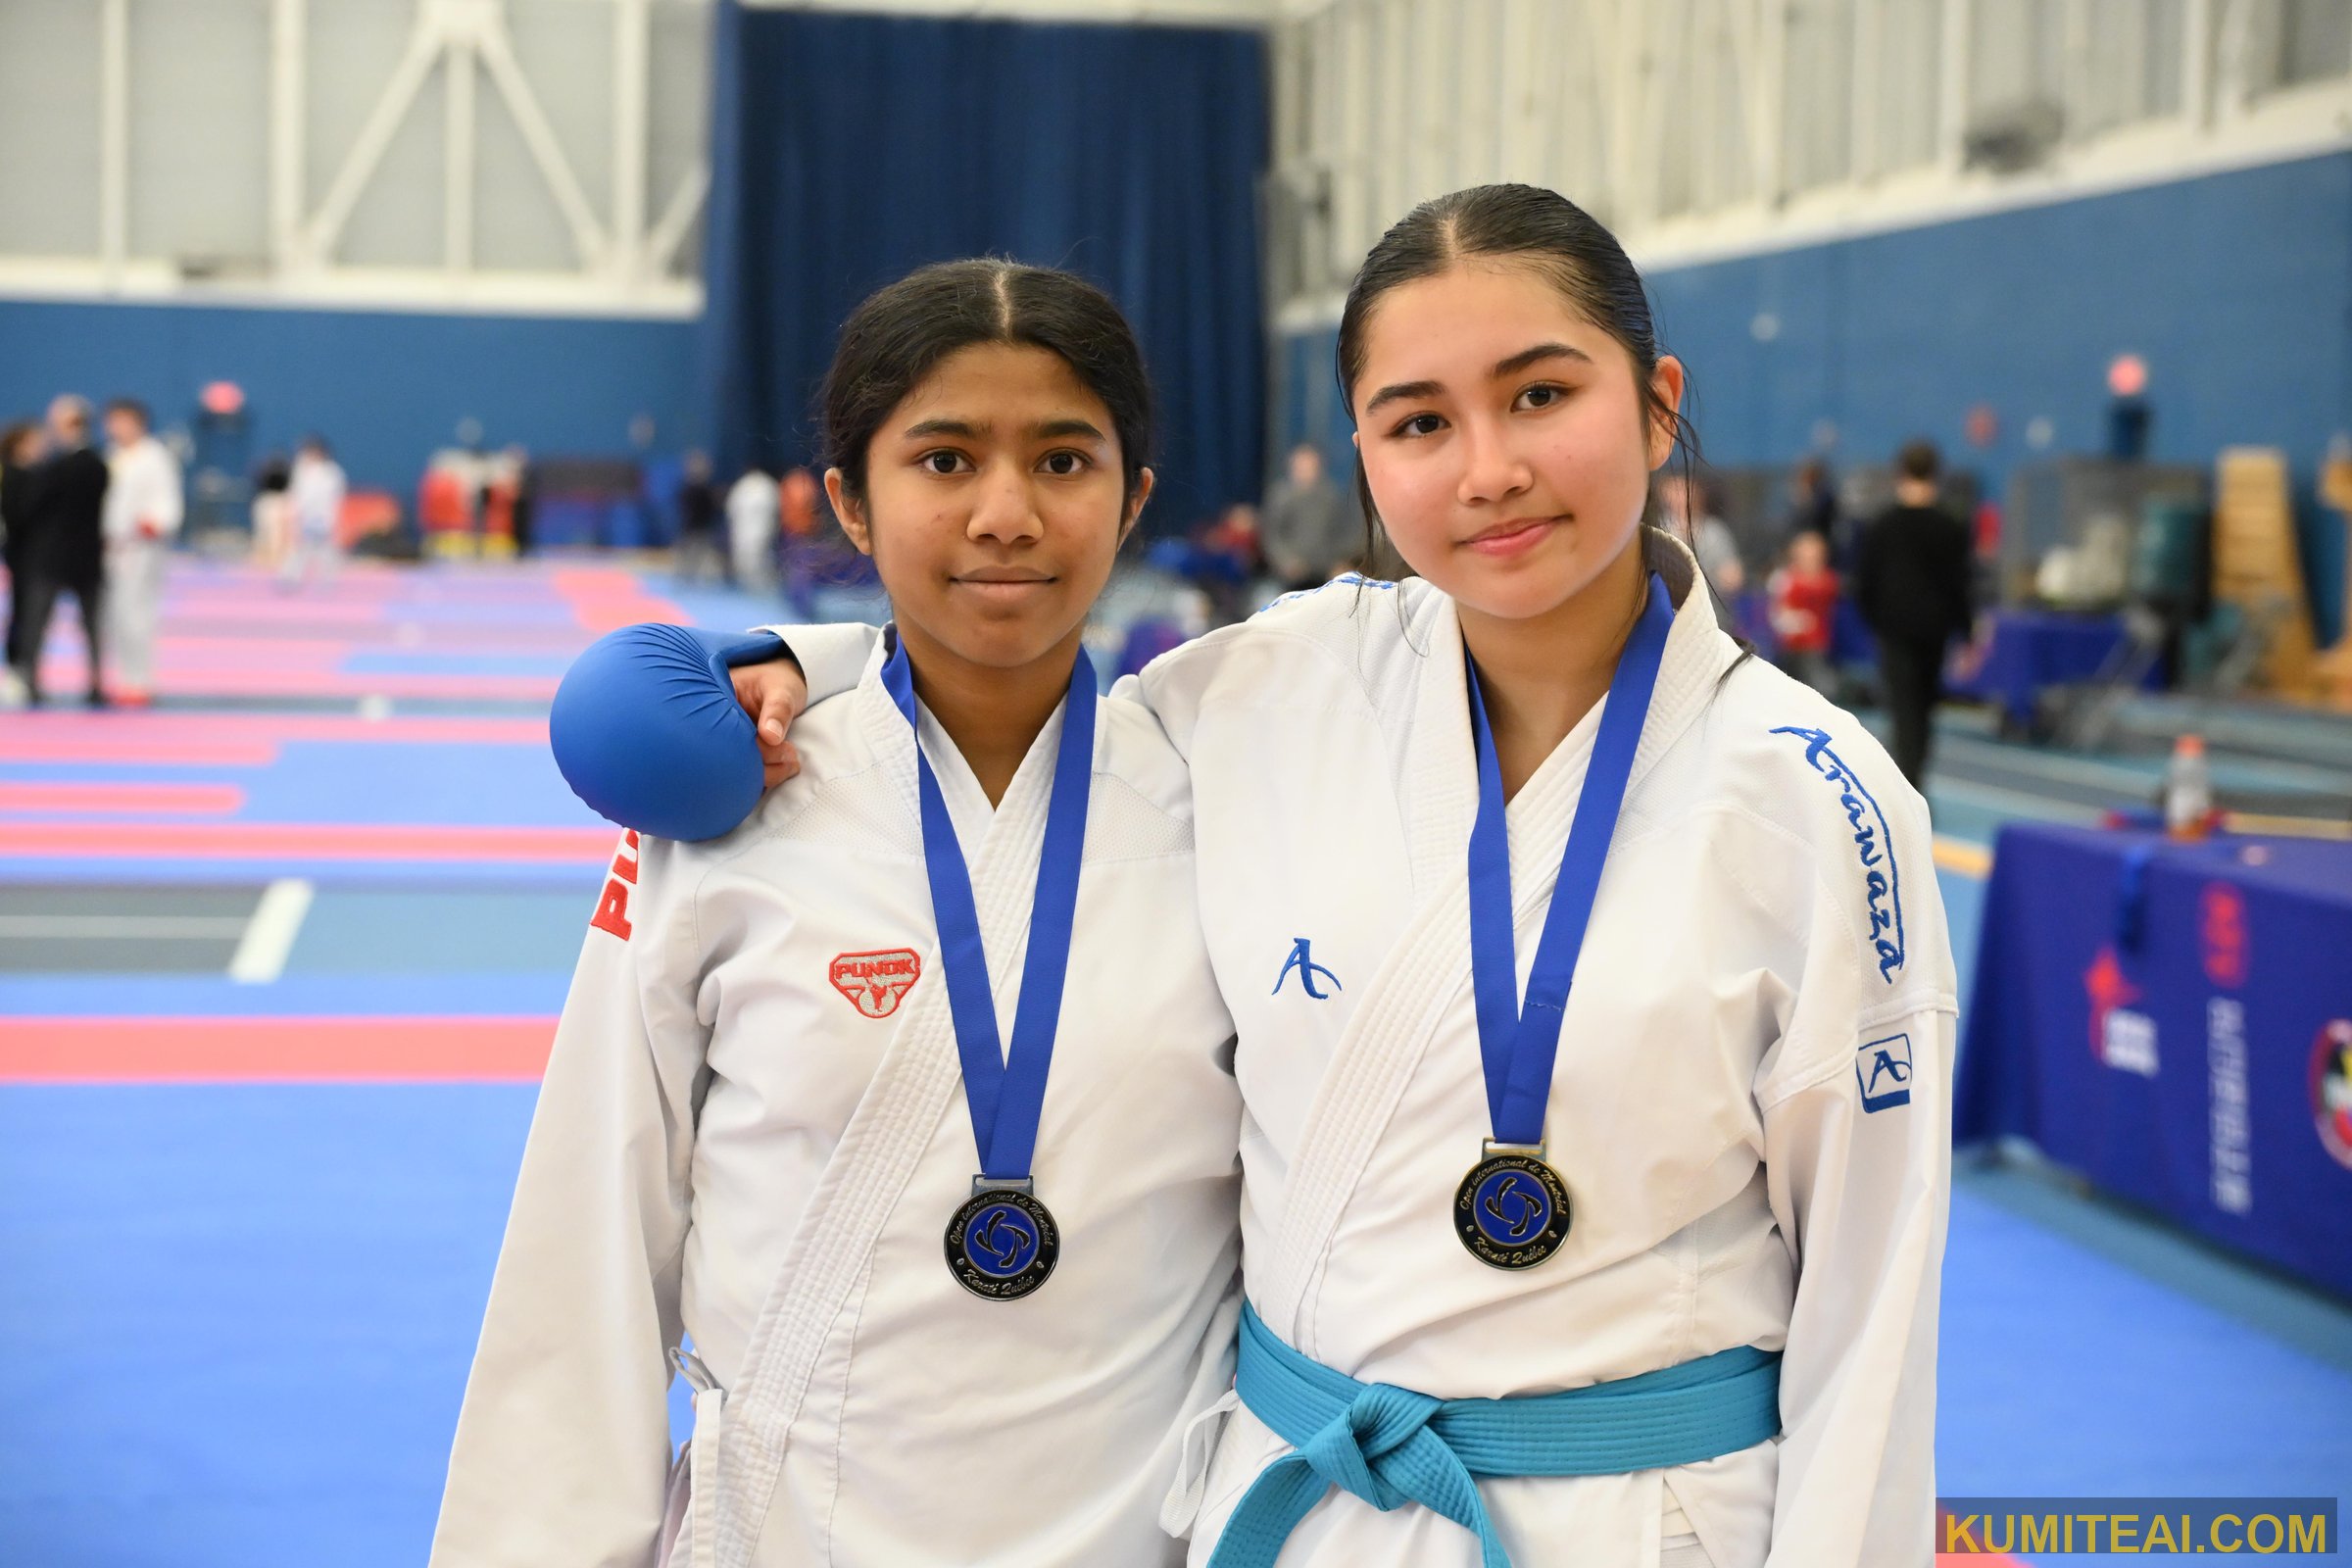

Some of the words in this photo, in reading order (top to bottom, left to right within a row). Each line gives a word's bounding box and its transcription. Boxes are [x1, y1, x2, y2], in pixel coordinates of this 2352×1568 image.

[1768, 725, 1905, 985] Arawaza
[1459, 1187, 1474, 1211] Open
[1472, 1158, 1528, 1187] international
[1528, 1162, 1541, 1174] de
[950, 1219, 964, 1245] Open
[962, 1193, 1016, 1220] international
[1016, 1196, 1029, 1208] de
